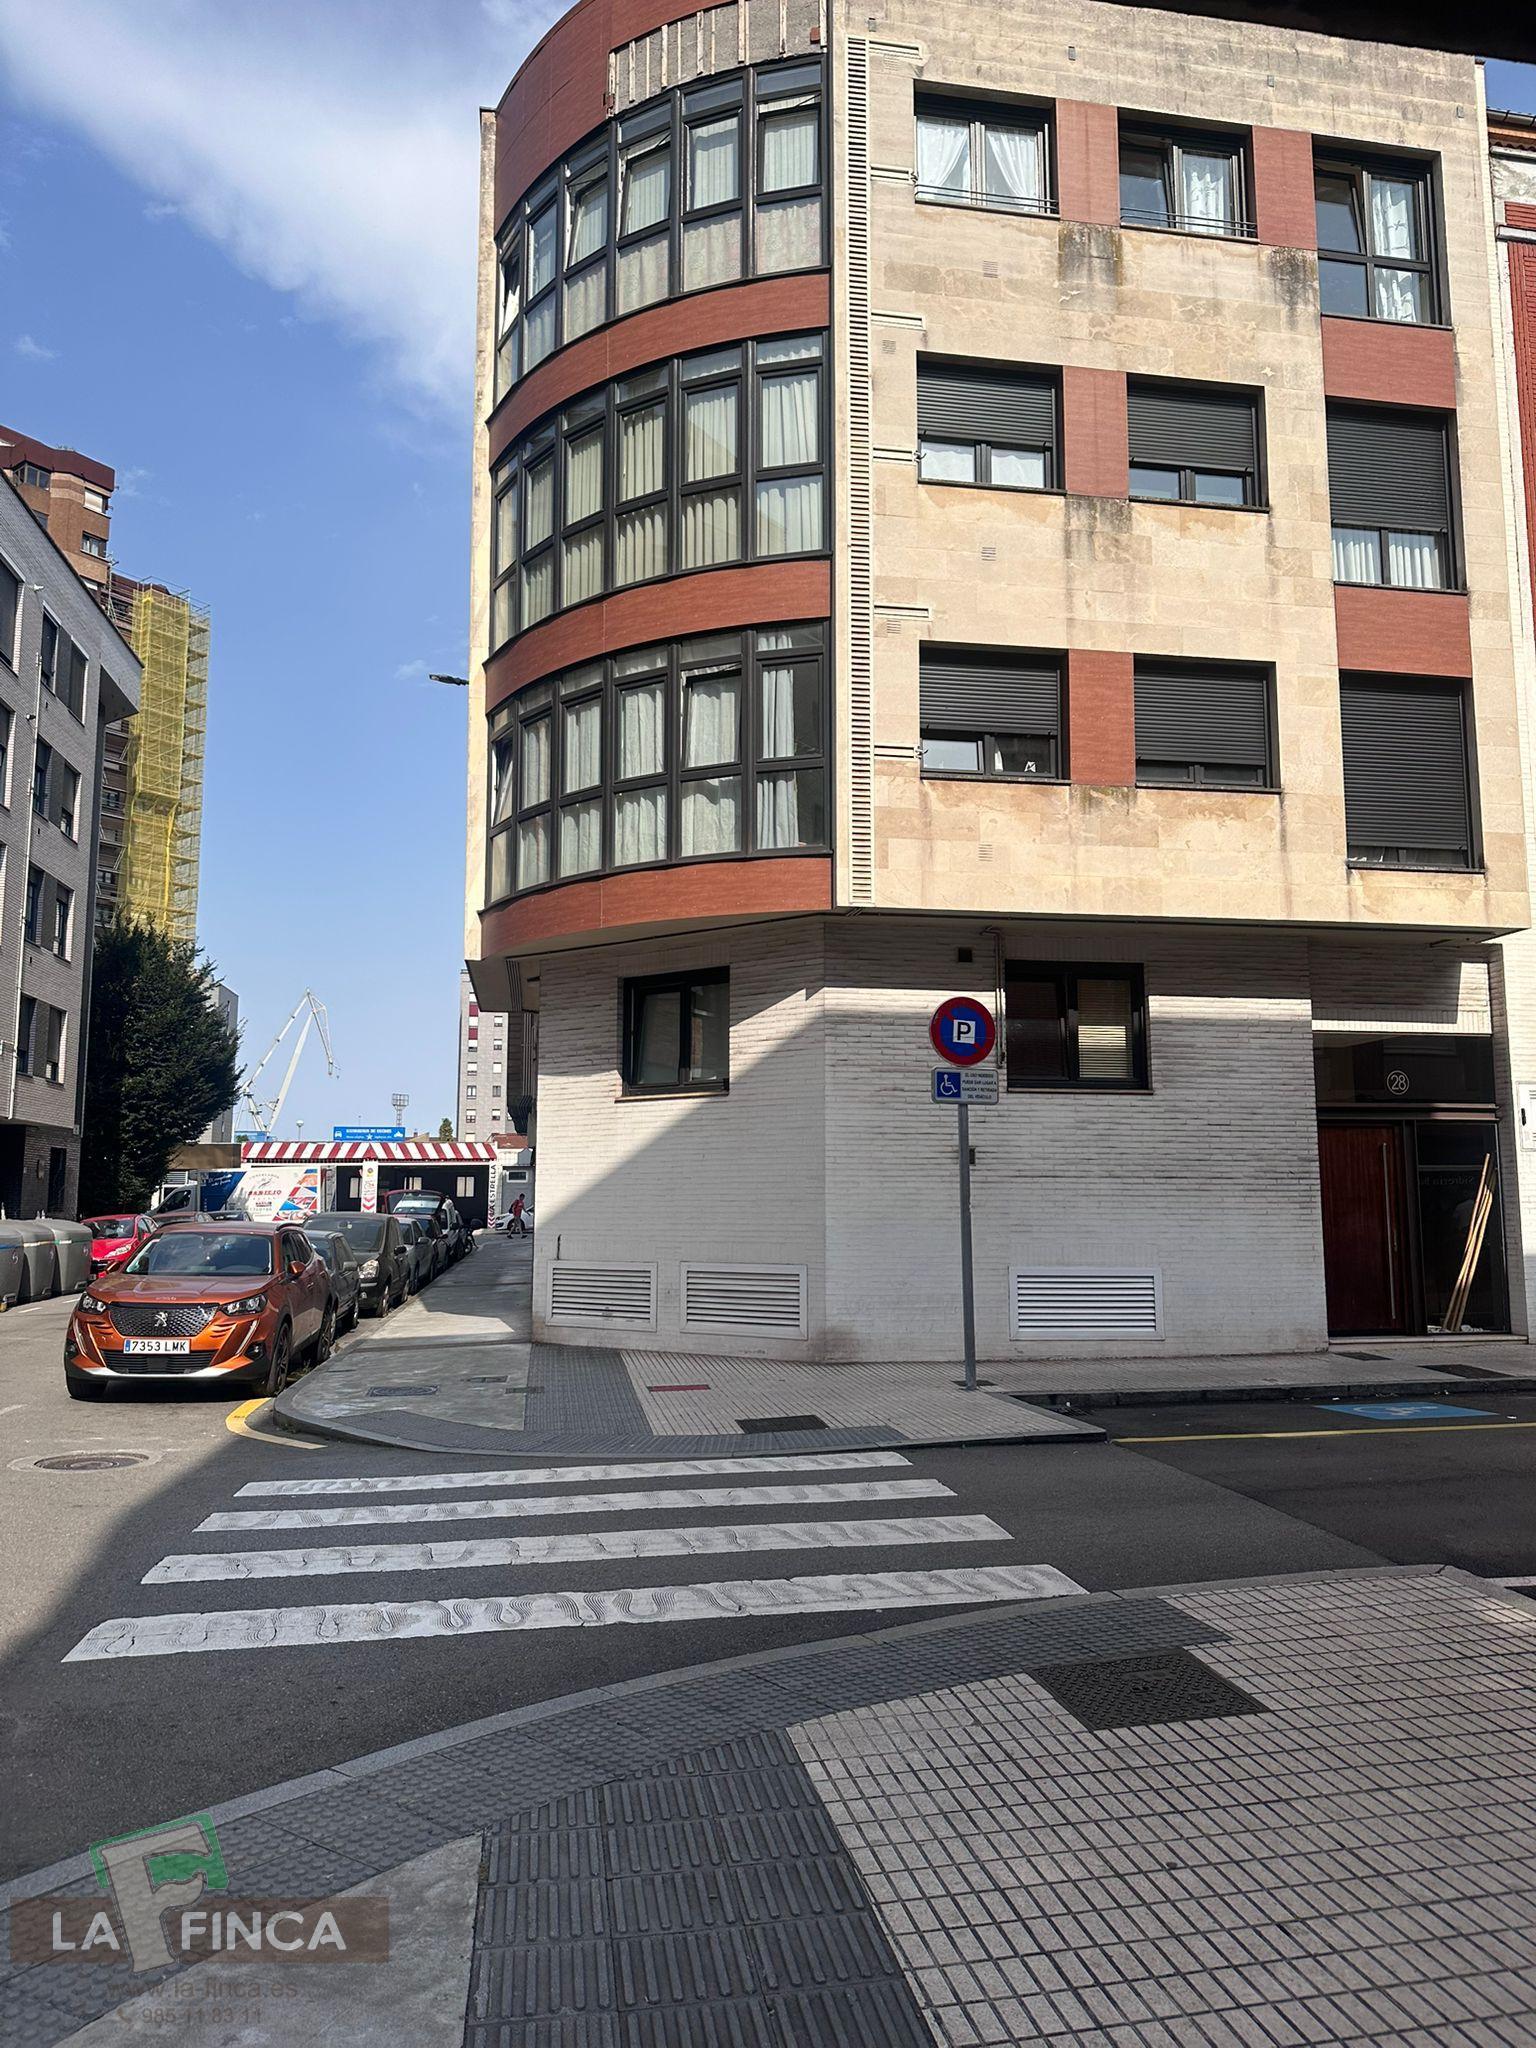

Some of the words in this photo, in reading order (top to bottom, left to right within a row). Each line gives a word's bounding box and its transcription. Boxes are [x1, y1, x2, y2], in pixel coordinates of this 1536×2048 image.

[957, 1021, 971, 1041] P
[1391, 1074, 1407, 1091] 28
[132, 1341, 161, 1352] 7353
[164, 1341, 187, 1352] LMK
